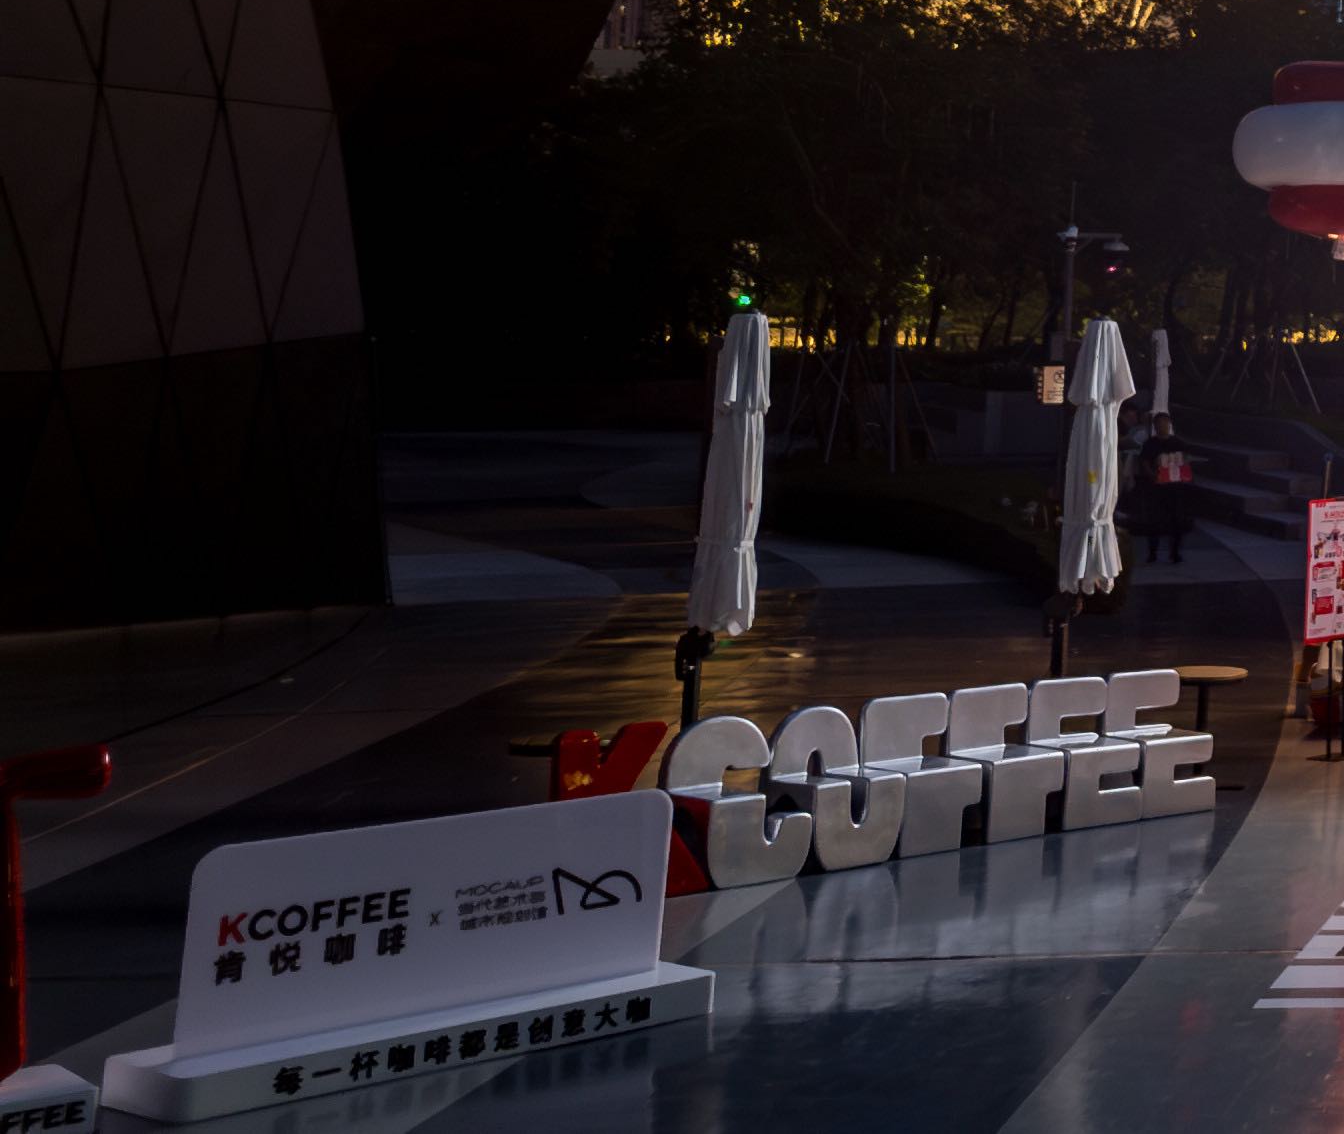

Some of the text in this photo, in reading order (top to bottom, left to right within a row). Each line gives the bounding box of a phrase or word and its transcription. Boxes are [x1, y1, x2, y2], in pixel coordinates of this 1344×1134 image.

[217, 888, 411, 948] KCOFFEE
[213, 927, 408, 987] 肯悦咖啡
[273, 996, 652, 1096] 每一杯咖啡都是创意大咖
